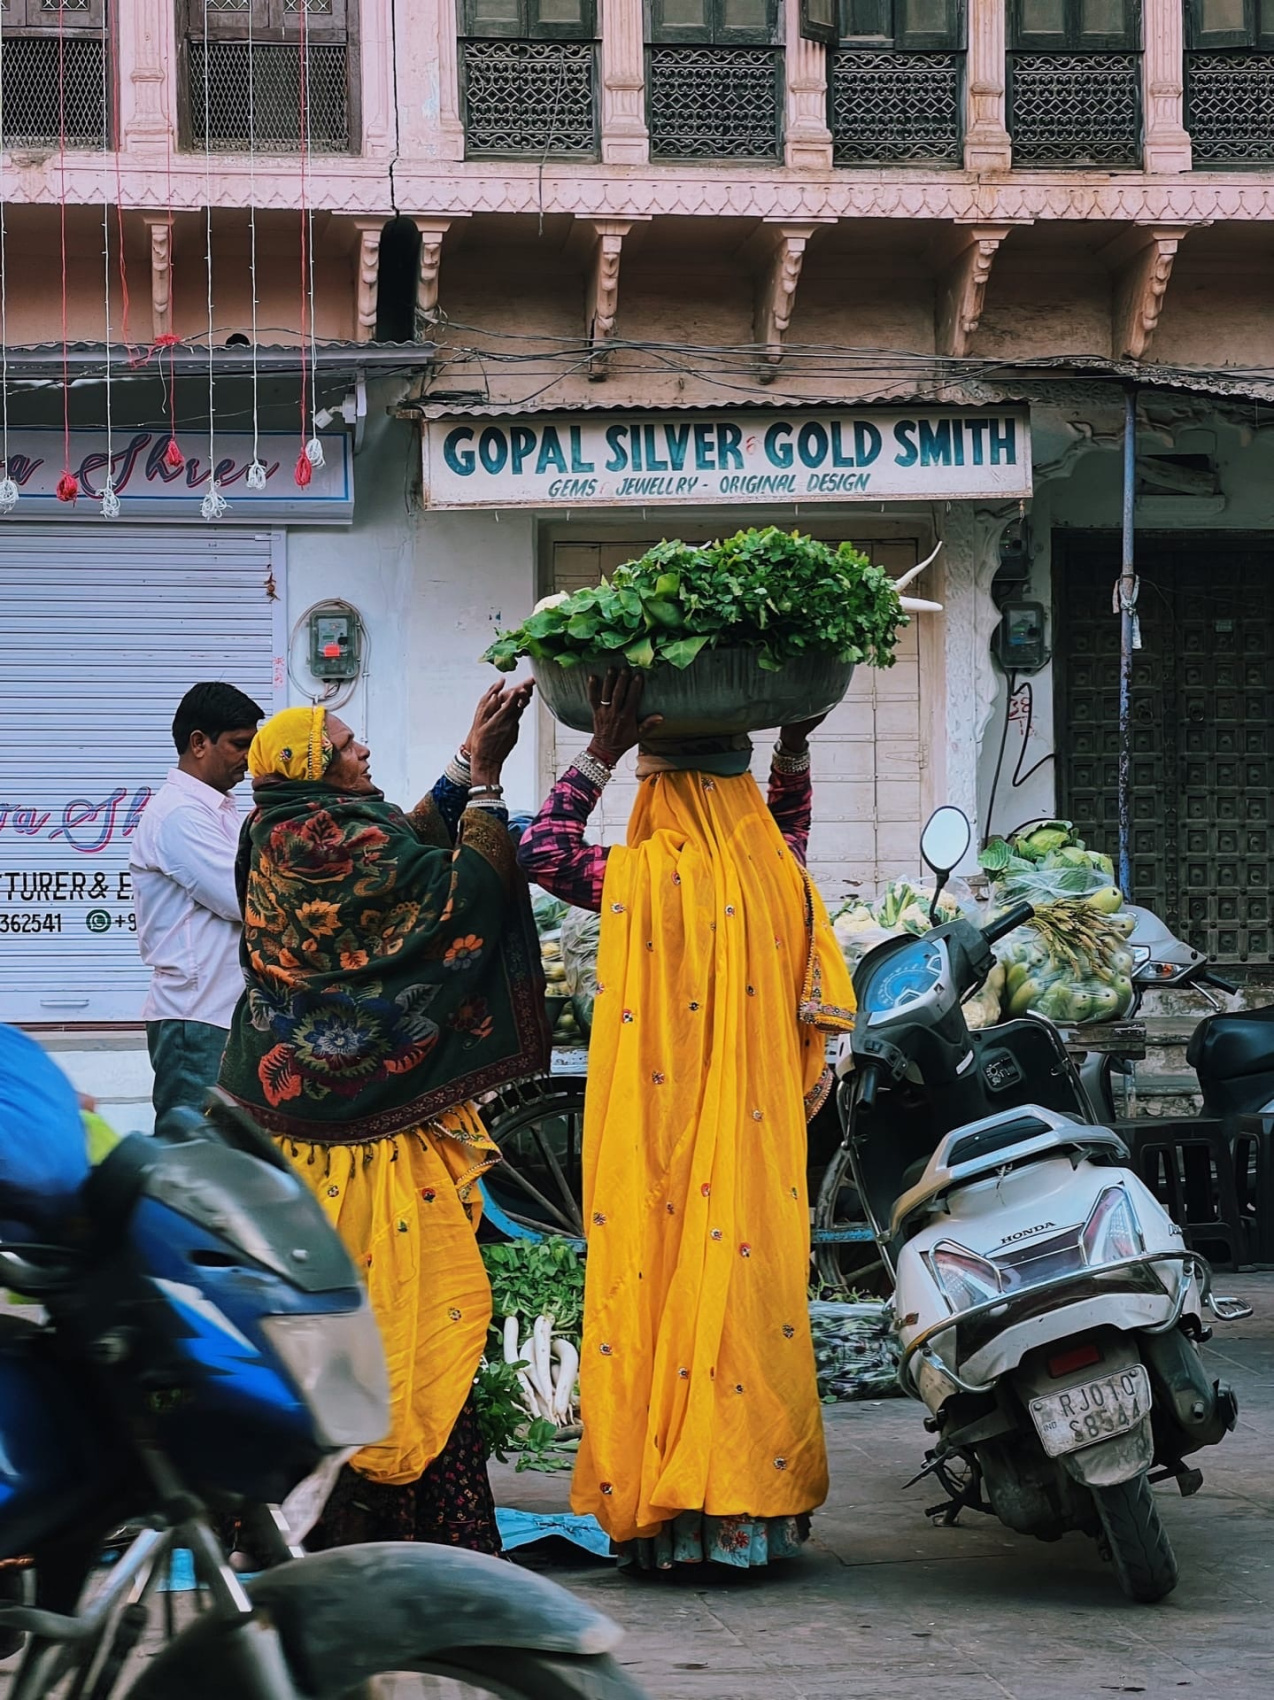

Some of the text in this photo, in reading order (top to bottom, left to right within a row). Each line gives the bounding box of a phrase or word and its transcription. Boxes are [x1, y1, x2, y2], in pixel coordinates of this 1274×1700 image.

[443, 425, 595, 477] GOPAL
[605, 422, 745, 472] SILVER
[764, 420, 883, 469] GOLD
[894, 418, 1017, 468] SMITH
[548, 478, 598, 498] GEMS
[616, 476, 699, 496] JEWELLRY
[719, 474, 797, 495] ORIGINAL
[806, 472, 871, 493] DESIGN
[117, 872, 134, 900] E
[1001, 1221, 1056, 1244] HONDA
[1058, 1375, 1136, 1417] RJ01Q
